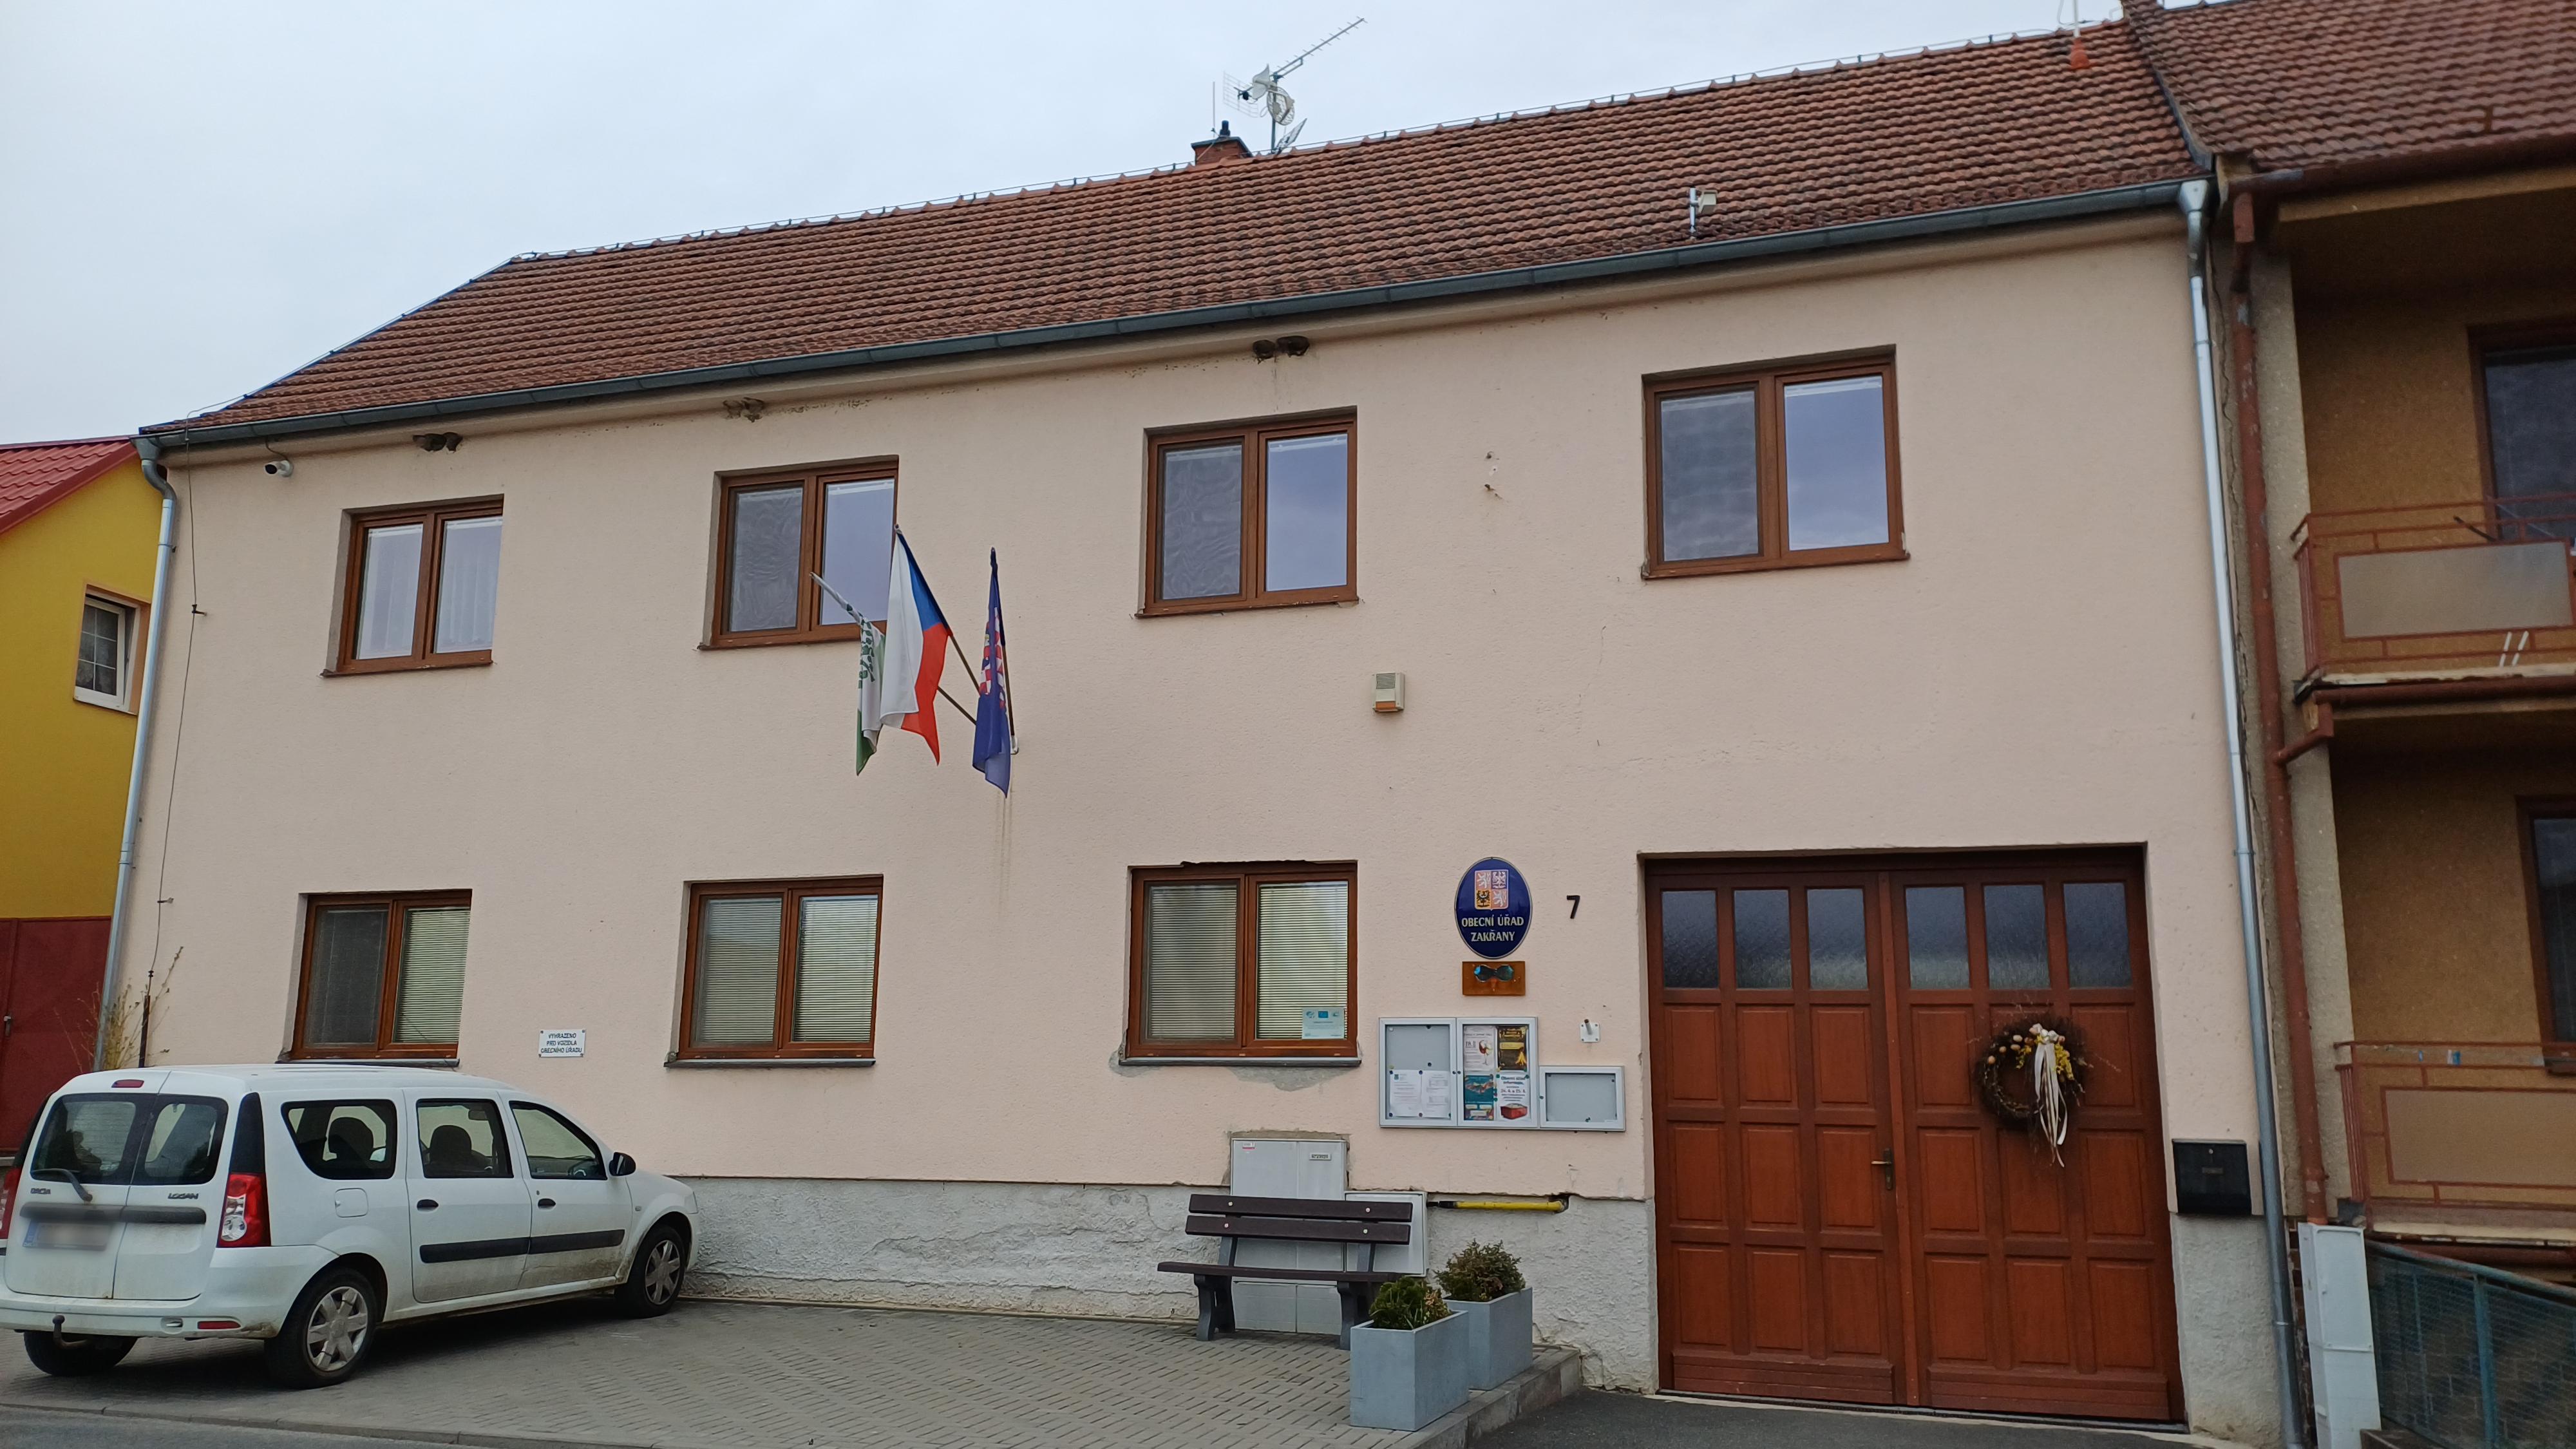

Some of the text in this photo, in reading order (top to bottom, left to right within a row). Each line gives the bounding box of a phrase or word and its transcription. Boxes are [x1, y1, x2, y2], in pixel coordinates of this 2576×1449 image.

[1566, 895, 1580, 919] 7
[1461, 914, 1524, 927] OBECNÍ ÚŘAD
[1470, 929, 1515, 942] ZAKŘANY
